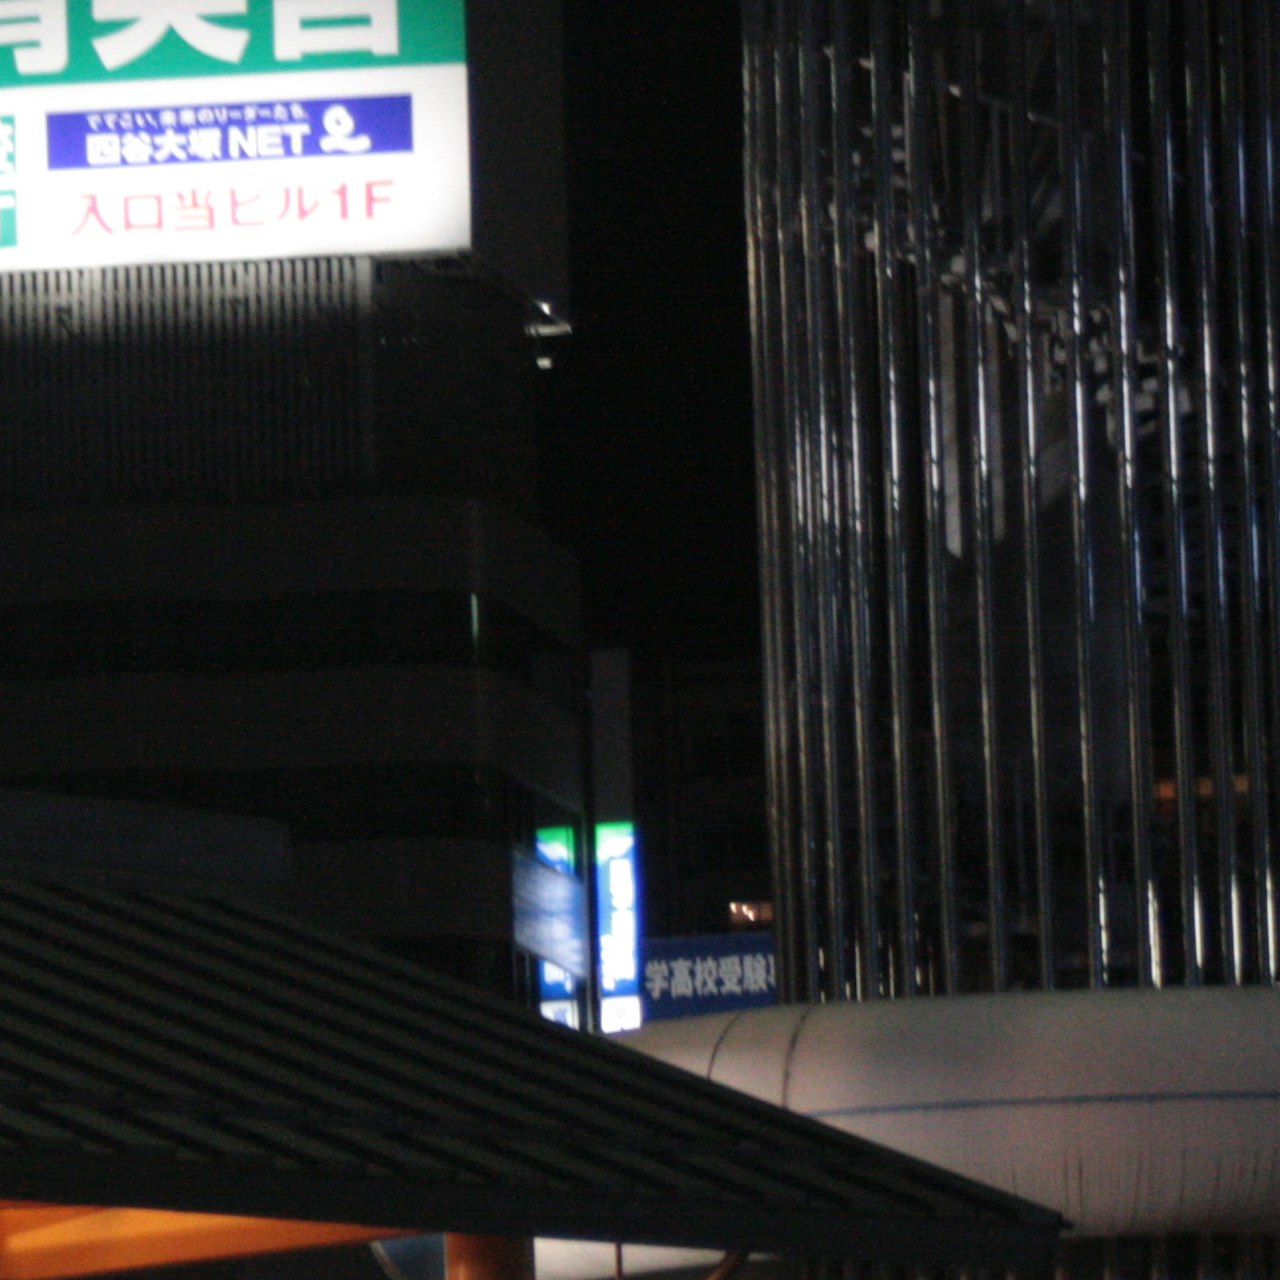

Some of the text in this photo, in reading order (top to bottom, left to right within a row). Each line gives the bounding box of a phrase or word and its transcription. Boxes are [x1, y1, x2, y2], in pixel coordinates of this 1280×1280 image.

[644, 953, 777, 1001] 学高校受験
